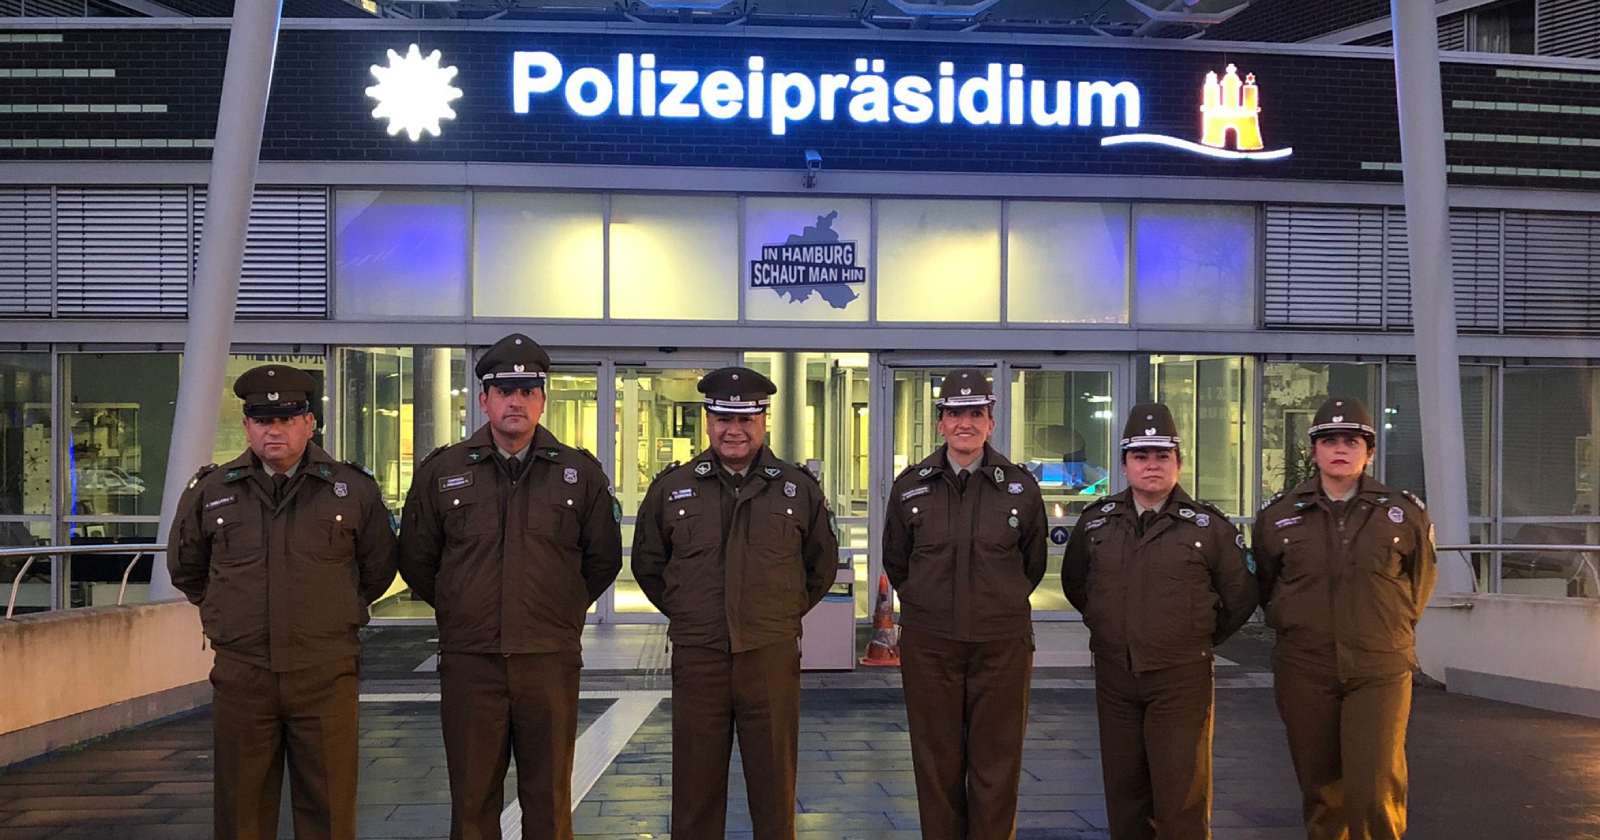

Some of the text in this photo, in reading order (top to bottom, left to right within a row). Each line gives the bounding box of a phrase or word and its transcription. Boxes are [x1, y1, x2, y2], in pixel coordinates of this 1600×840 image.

[512, 50, 1141, 136] Polizeipräsidium
[764, 244, 853, 265] IN HAMBURG
[754, 262, 864, 285] SCHAUT MAN HIN
